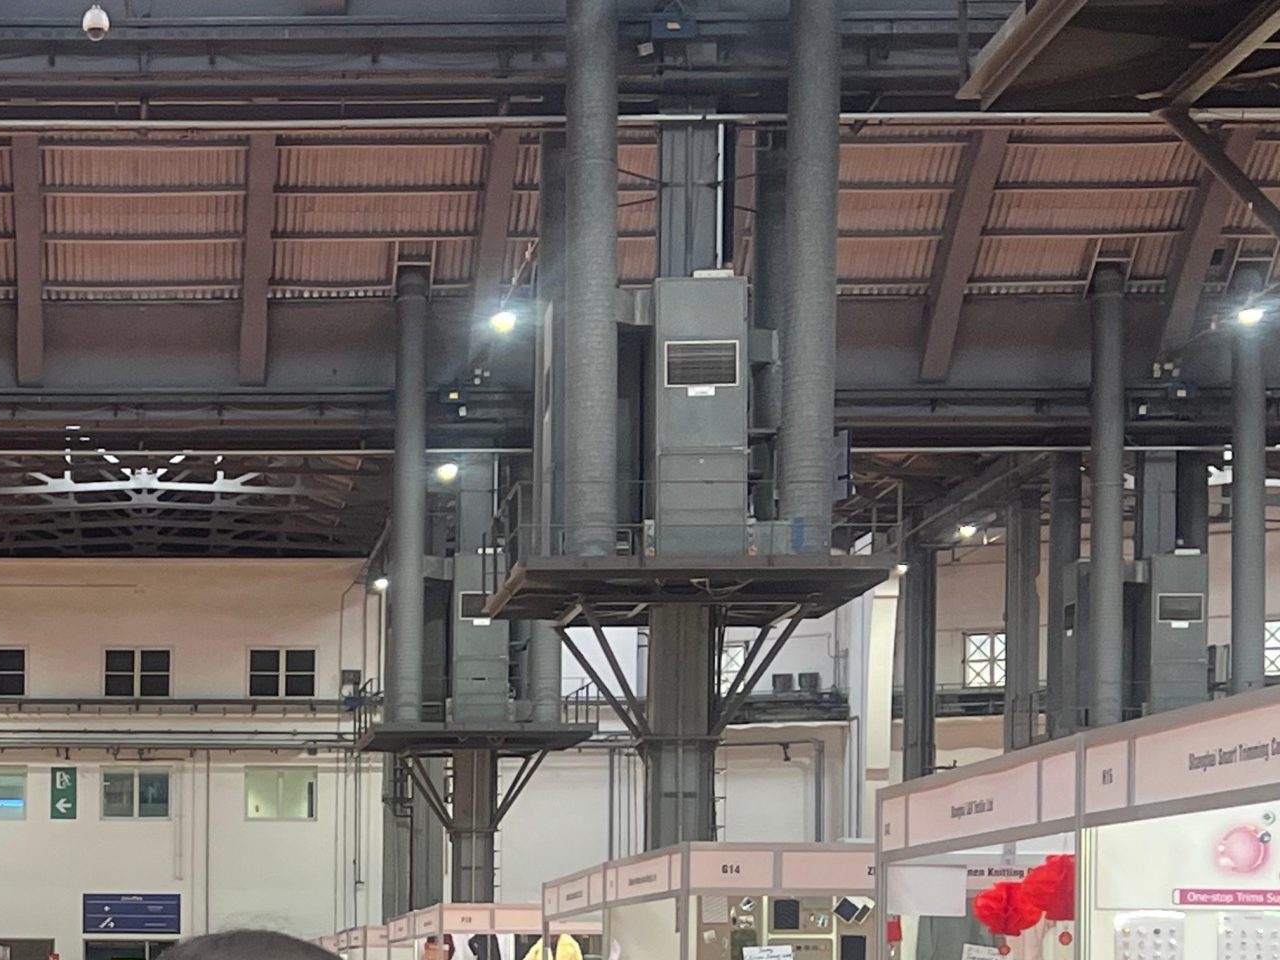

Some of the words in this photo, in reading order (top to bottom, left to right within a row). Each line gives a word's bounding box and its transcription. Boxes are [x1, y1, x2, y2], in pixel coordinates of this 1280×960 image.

[721, 864, 740, 874] G14
[1186, 891, 1234, 904] One-stop
[1235, 891, 1264, 903] Trims
